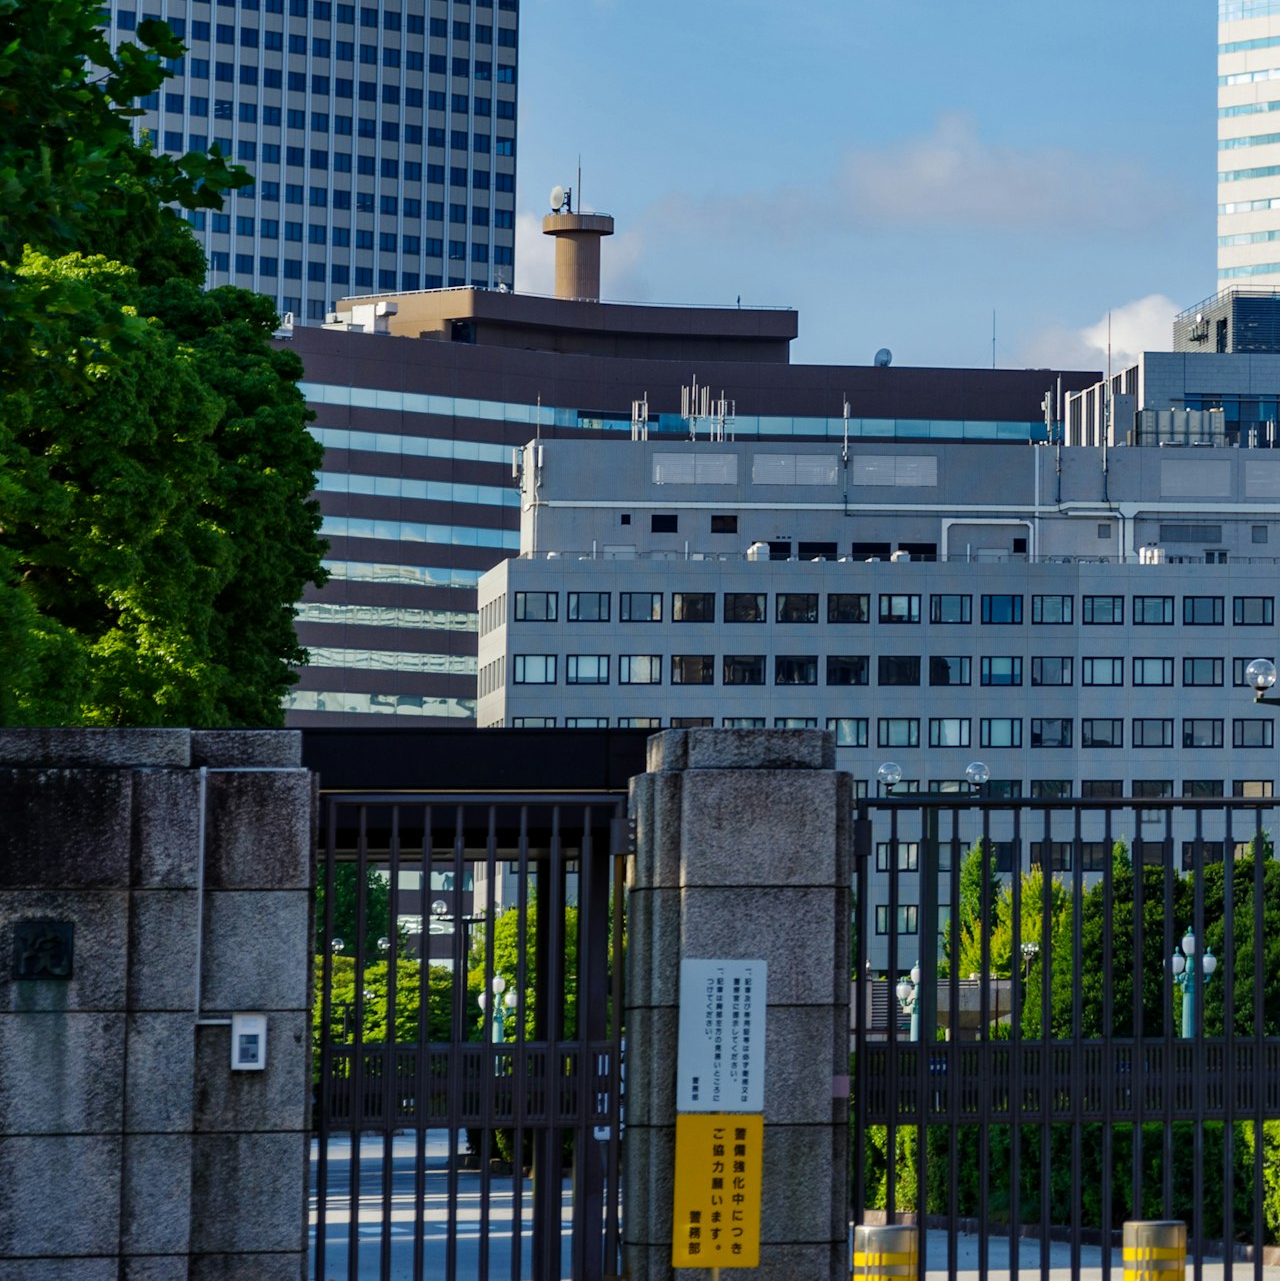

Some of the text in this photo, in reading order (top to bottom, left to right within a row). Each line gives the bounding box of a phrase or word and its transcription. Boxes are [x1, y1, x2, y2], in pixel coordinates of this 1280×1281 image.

[705, 978, 715, 1040] つけてください。
[688, 1211, 702, 1256] 警務部
[710, 1128, 726, 1251] ご協力願います。
[731, 1128, 747, 1255] 警備強化中につき
